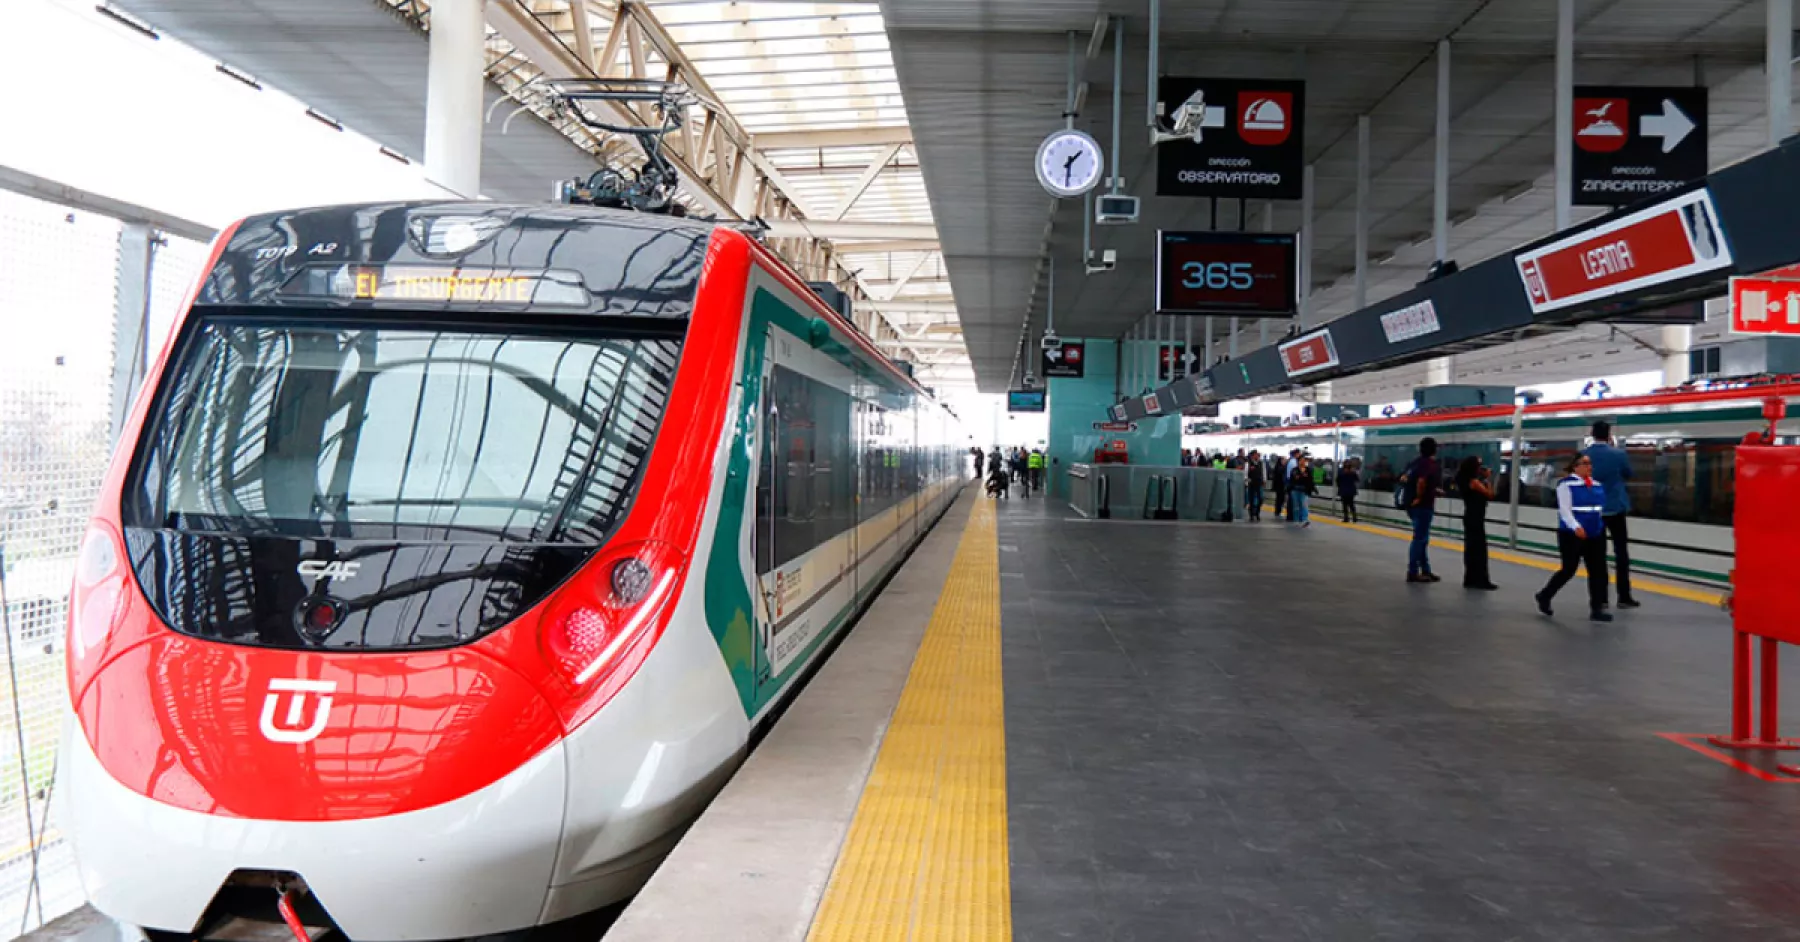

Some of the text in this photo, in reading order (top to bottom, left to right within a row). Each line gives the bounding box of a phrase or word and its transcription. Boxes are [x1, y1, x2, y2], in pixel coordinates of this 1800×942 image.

[1178, 170, 1281, 184] OBSERVATORIO
[308, 242, 338, 256] A2
[1579, 239, 1636, 280] LERMA
[356, 273, 530, 301] EL INSURGENTE
[1181, 261, 1254, 290] 365
[297, 560, 361, 582] CAF
